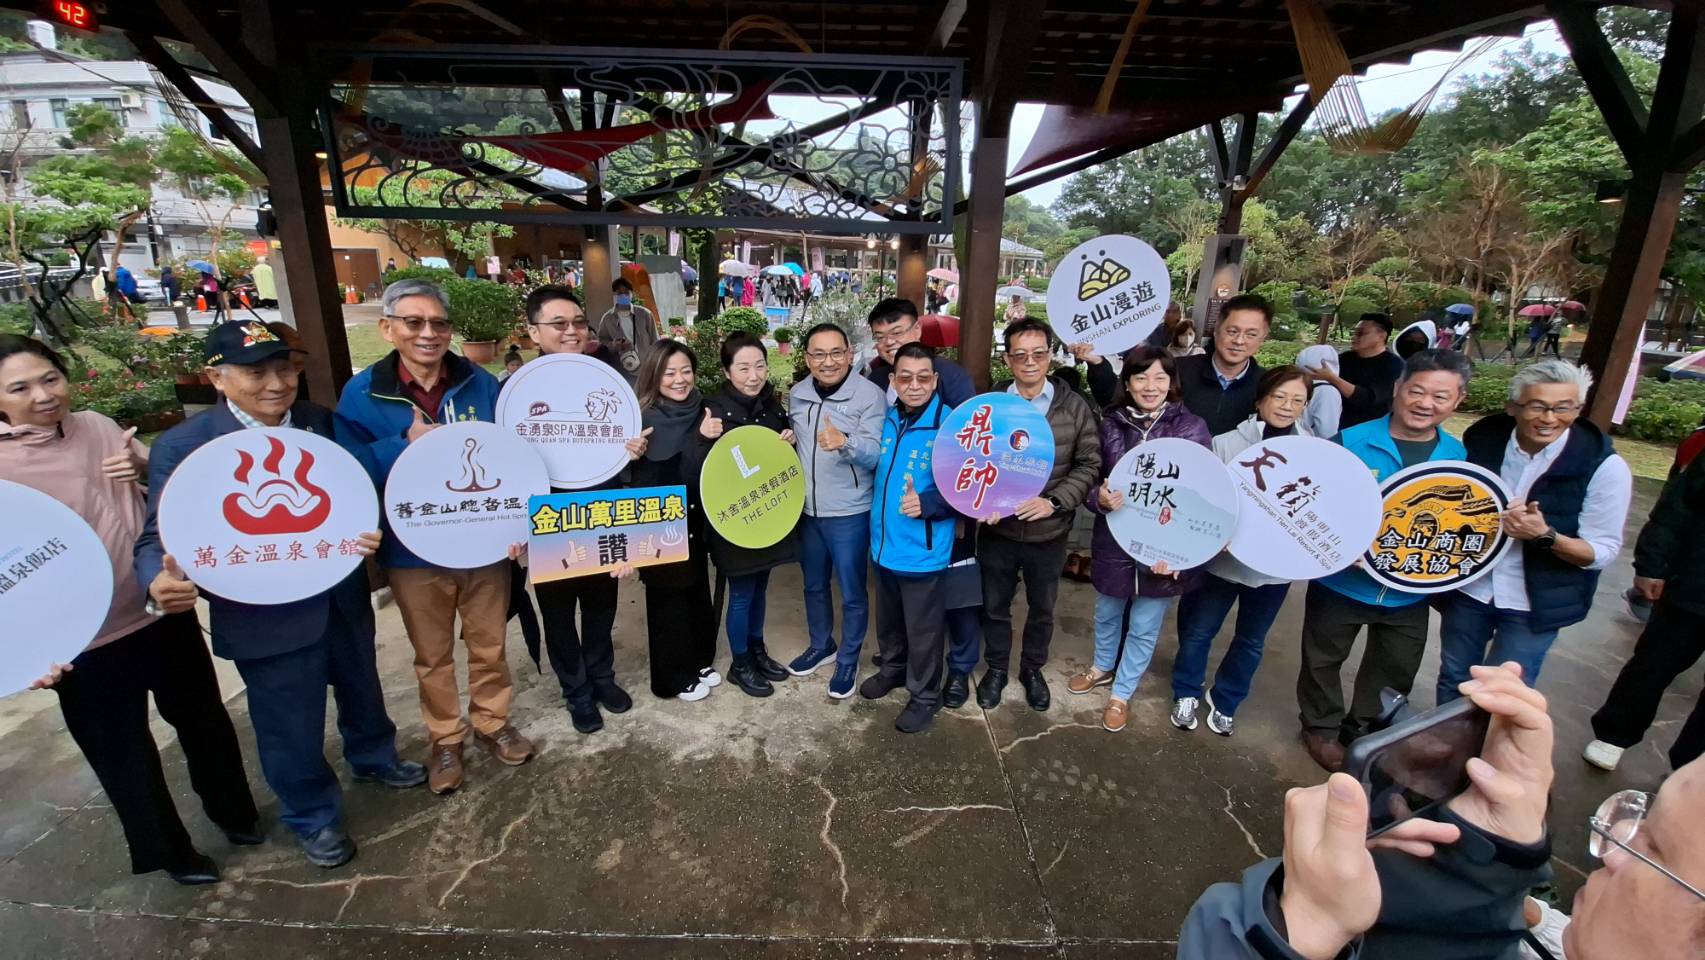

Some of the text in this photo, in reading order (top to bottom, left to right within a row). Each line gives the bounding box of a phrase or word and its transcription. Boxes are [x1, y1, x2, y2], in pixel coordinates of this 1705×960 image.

[59, 2, 84, 25] 42
[1070, 280, 1156, 335] 金山漫遊
[1113, 302, 1162, 330] EXPLORING
[531, 405, 548, 415] SPA
[730, 444, 760, 479] L
[956, 404, 999, 510] 鼎帥
[716, 464, 799, 524] 沐舍溫泉渡假酒店
[1238, 446, 1321, 518] 天籟
[531, 494, 686, 535] 金山萬里溫泉
[742, 489, 789, 526] THE LOFT
[598, 533, 629, 567] 讚
[1296, 536, 1316, 555] Resort
[1318, 557, 1333, 572] Spa
[1378, 528, 1486, 553] 金山商圈
[1373, 552, 1481, 576] 發展協會
